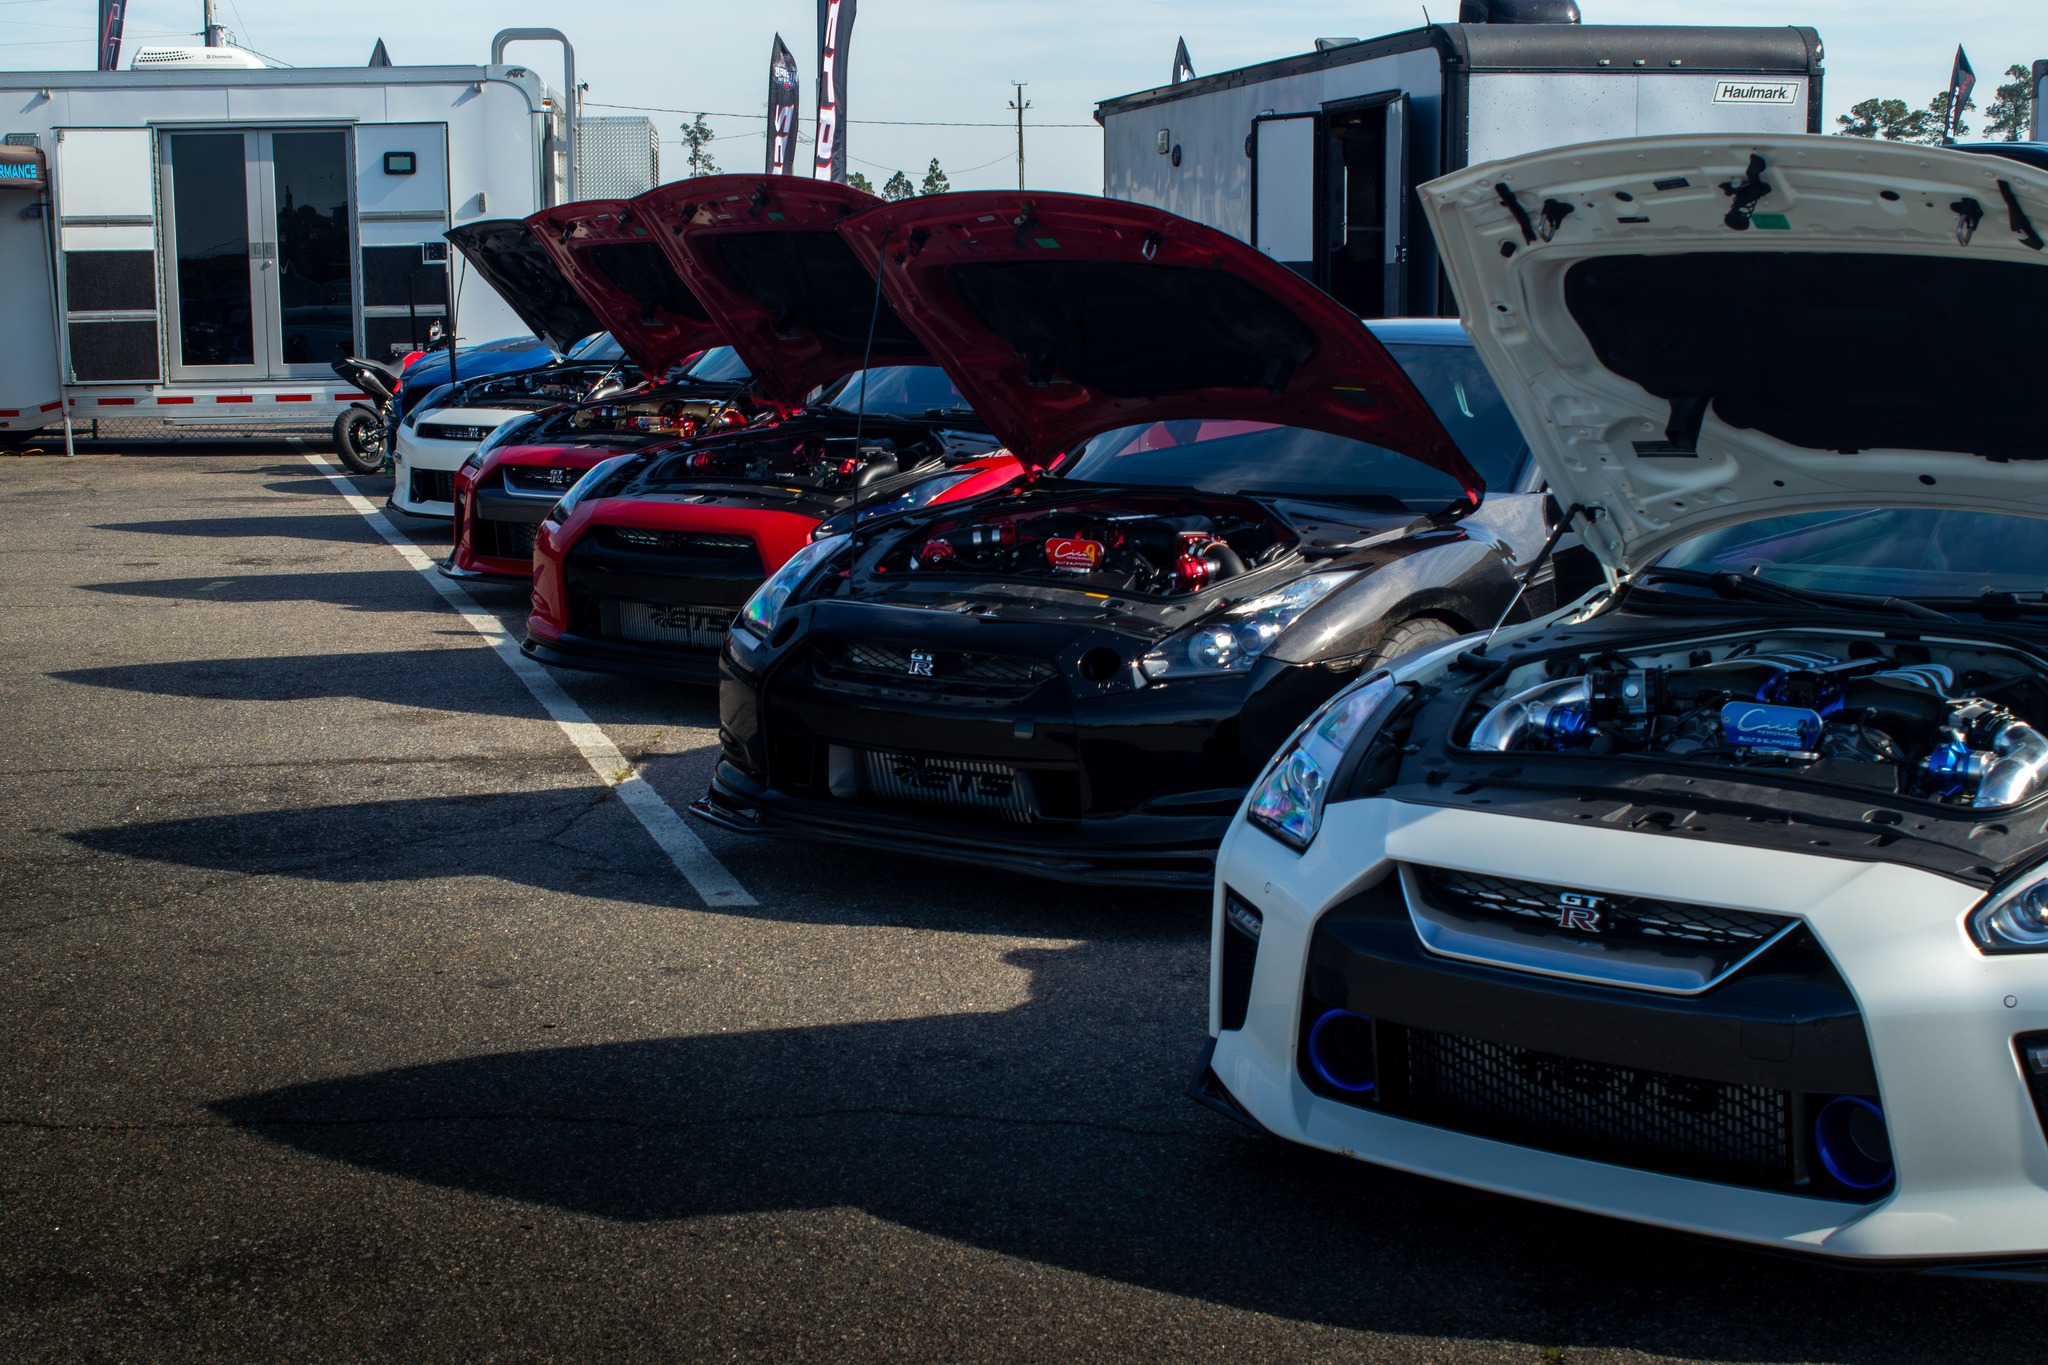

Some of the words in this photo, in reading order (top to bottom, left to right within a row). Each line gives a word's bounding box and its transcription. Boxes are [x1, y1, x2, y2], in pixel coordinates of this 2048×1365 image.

[1722, 85, 1787, 99] Haulmark
[908, 659, 933, 677] R
[924, 765, 1014, 798] ETS
[1560, 892, 1605, 908] GT
[1558, 904, 1600, 932] R
